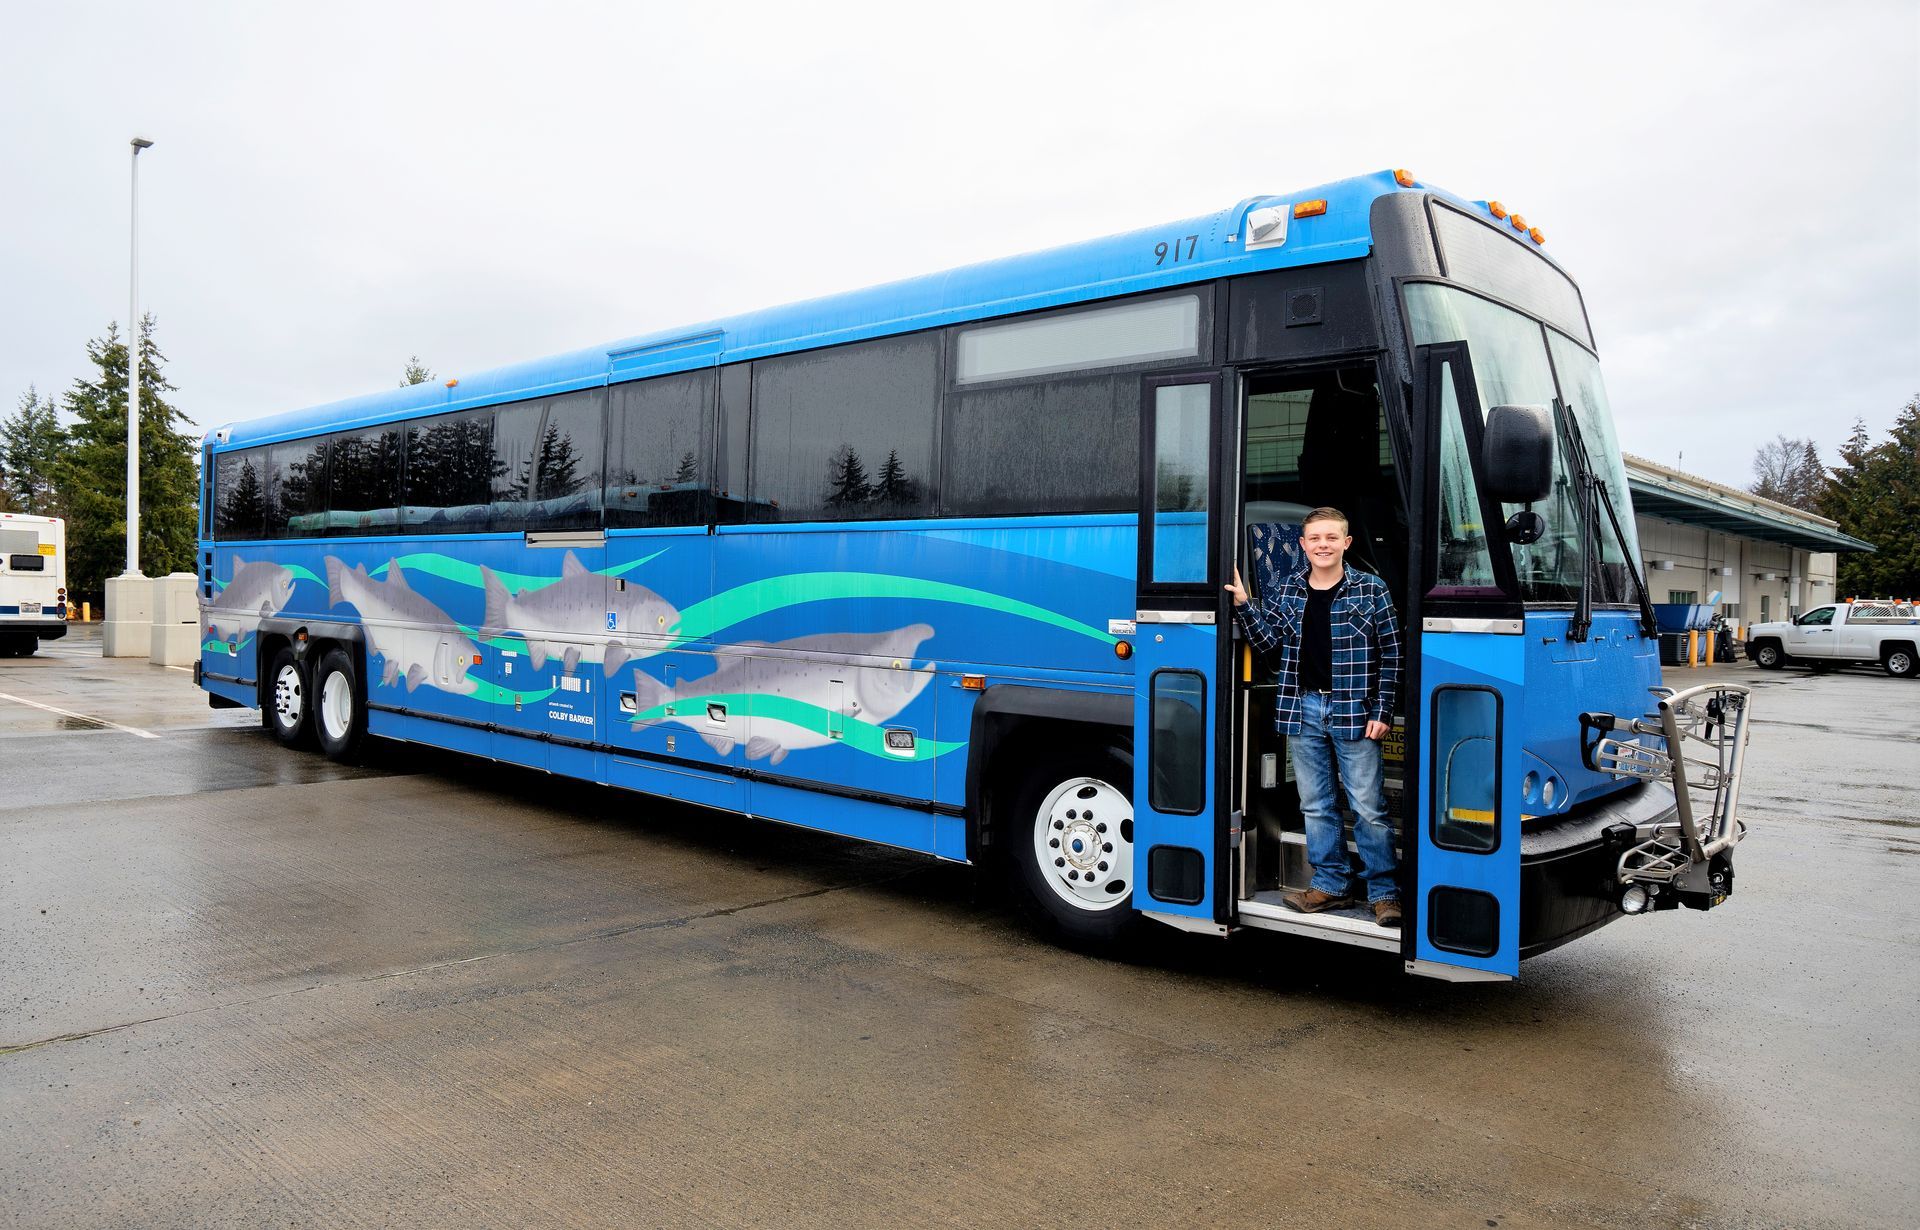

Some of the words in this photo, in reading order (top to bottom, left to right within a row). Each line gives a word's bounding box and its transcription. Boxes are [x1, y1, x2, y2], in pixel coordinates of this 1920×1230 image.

[1154, 234, 1199, 265] 917
[549, 710, 568, 720] COLBY
[569, 713, 593, 725] BARKER
